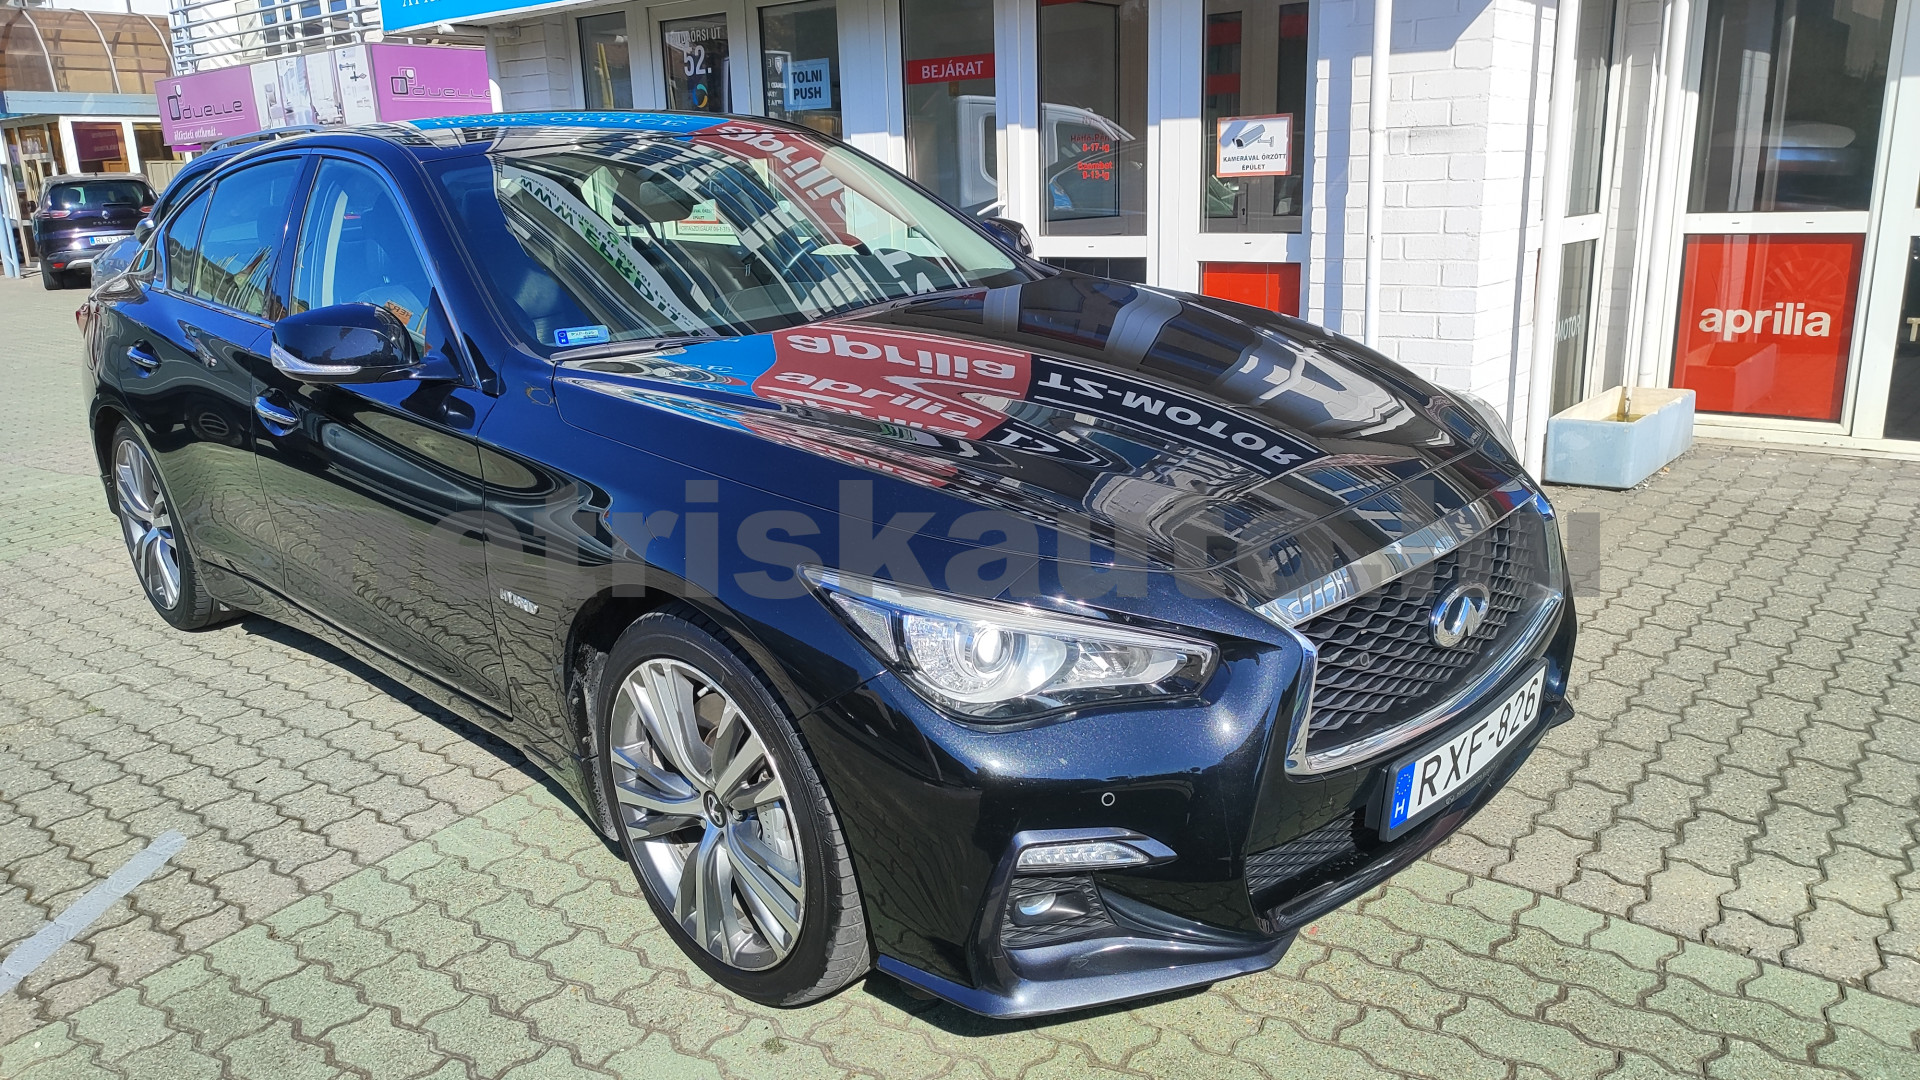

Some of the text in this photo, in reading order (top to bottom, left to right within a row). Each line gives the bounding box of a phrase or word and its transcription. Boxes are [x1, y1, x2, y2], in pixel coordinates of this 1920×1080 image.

[711, 25, 720, 40] ÚT
[683, 45, 712, 76] 52.
[921, 60, 983, 79] BEJÁRAT
[791, 69, 822, 85] TOLNI
[793, 87, 822, 100] PUSH
[1223, 154, 1260, 163] KAMERÁVAL
[1699, 302, 1832, 342] aprilia
[1416, 677, 1538, 807] RXF-826
[1394, 798, 1406, 819] H
